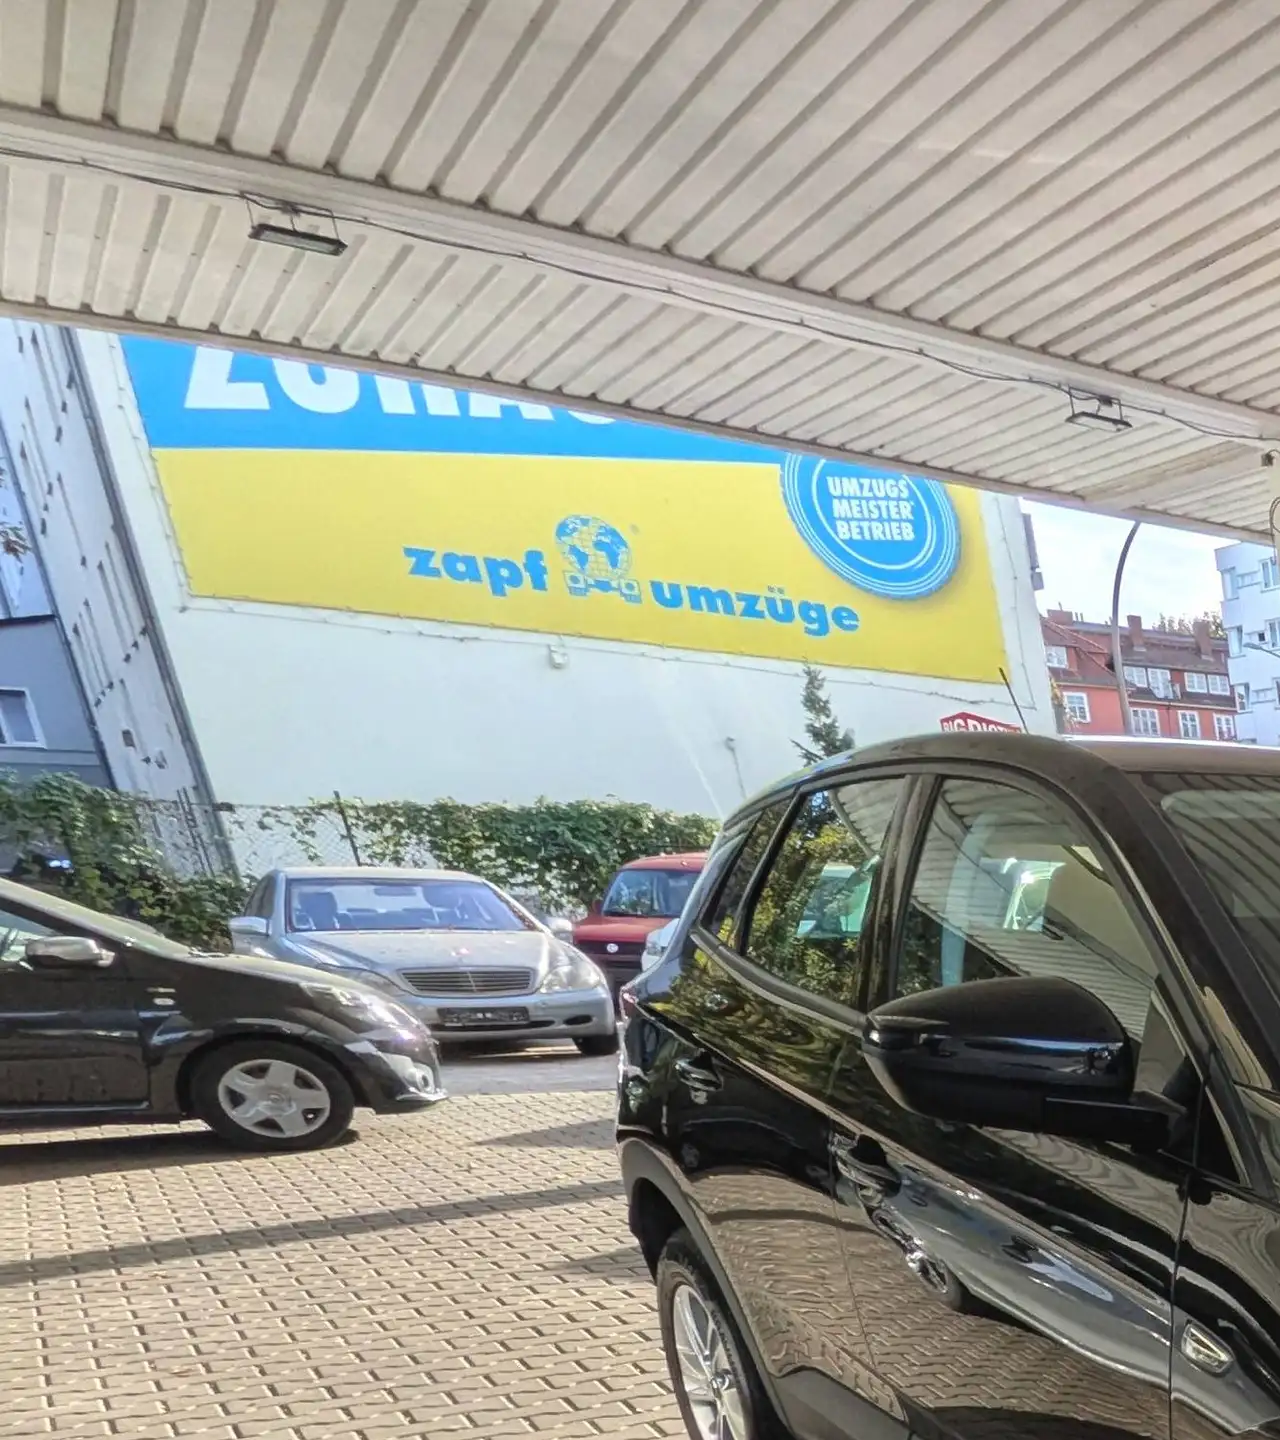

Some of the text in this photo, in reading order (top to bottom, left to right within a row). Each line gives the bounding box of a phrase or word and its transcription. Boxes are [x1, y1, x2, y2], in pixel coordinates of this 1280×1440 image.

[826, 475, 910, 499] UMZUGS
[836, 520, 915, 541] BETRIEB
[402, 544, 860, 637] zapf umzüge
